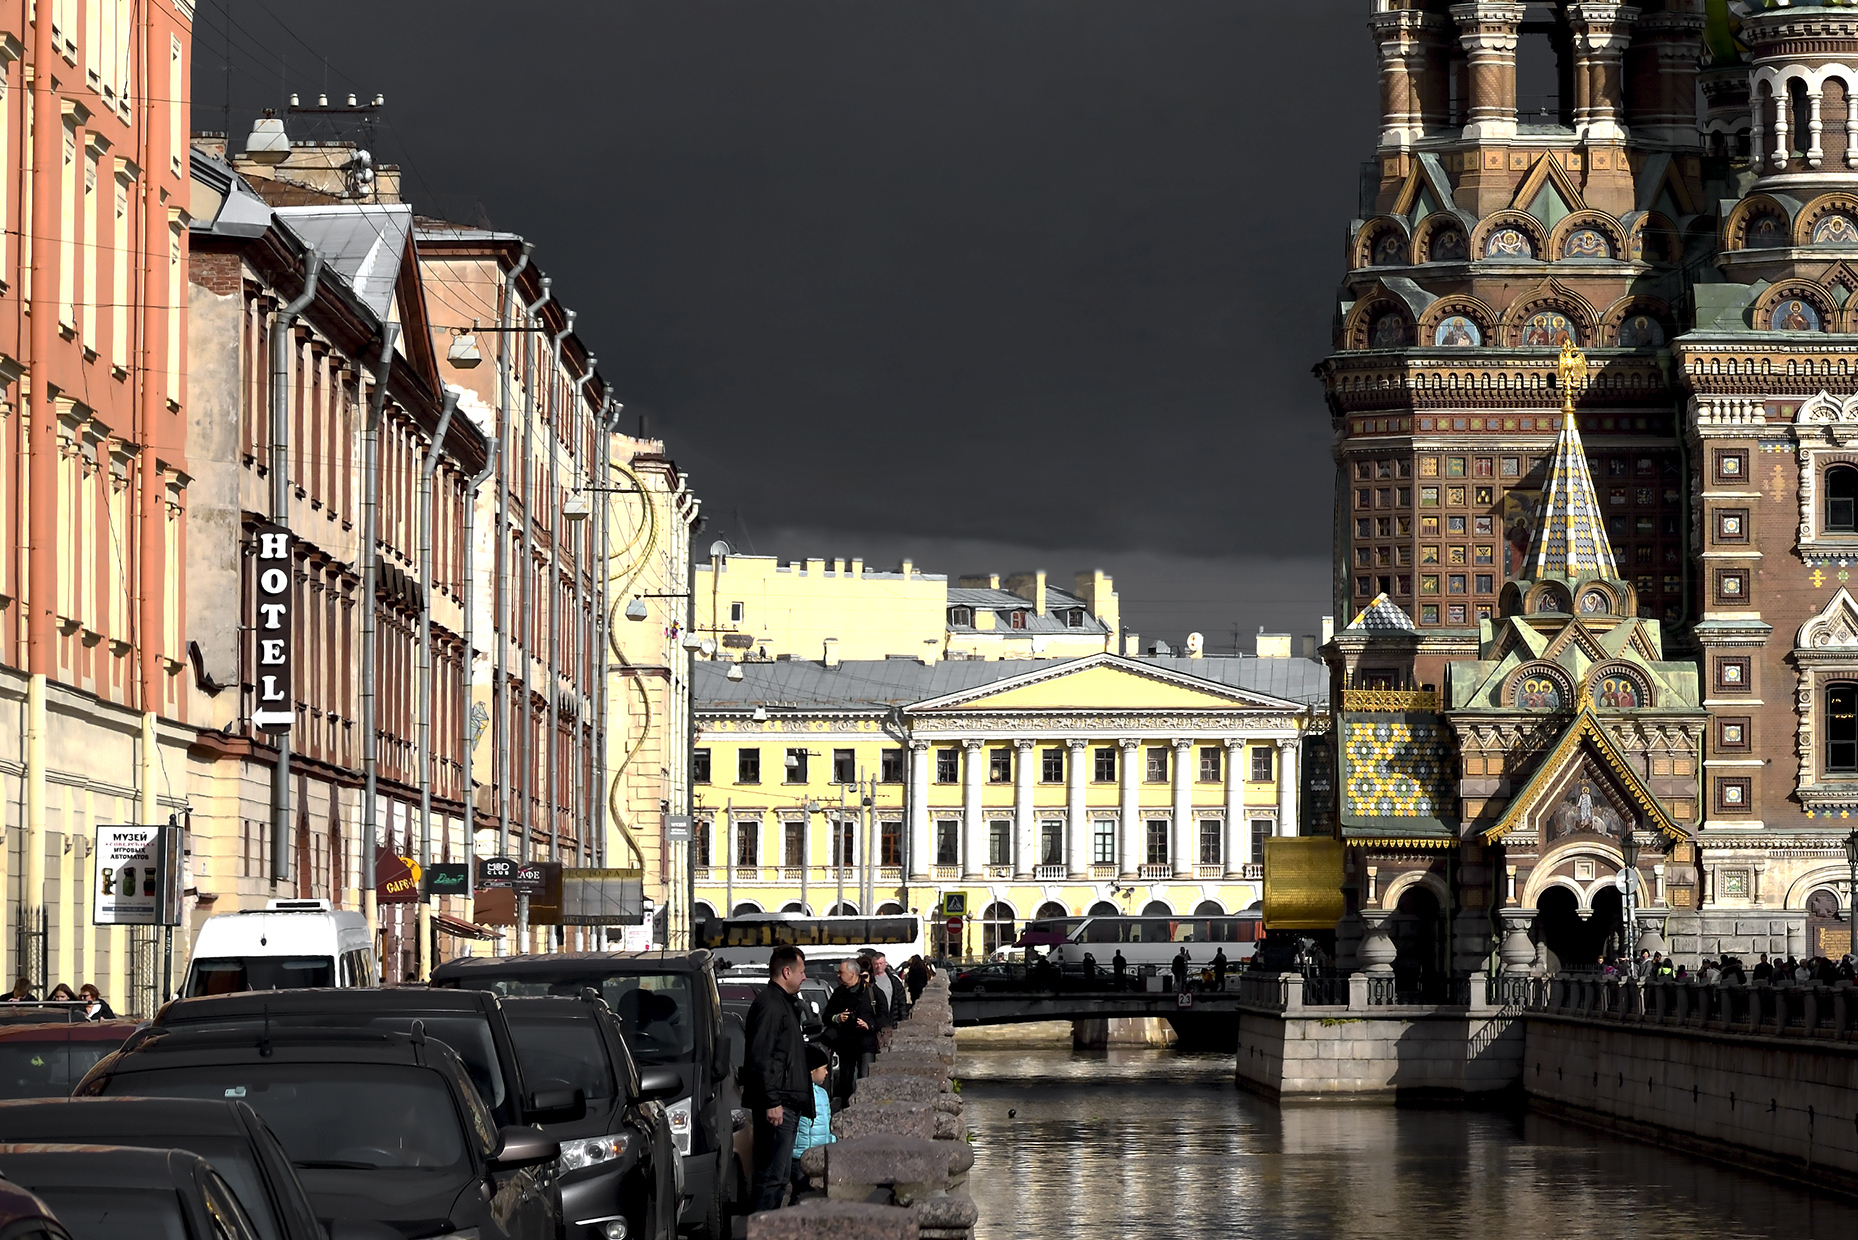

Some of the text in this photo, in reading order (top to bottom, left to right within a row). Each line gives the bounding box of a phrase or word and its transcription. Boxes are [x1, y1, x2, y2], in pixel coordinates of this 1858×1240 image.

[260, 533, 288, 701] HOTEL
[113, 831, 147, 841] МУЗЕЙ
[518, 871, 540, 879] АФЕ
